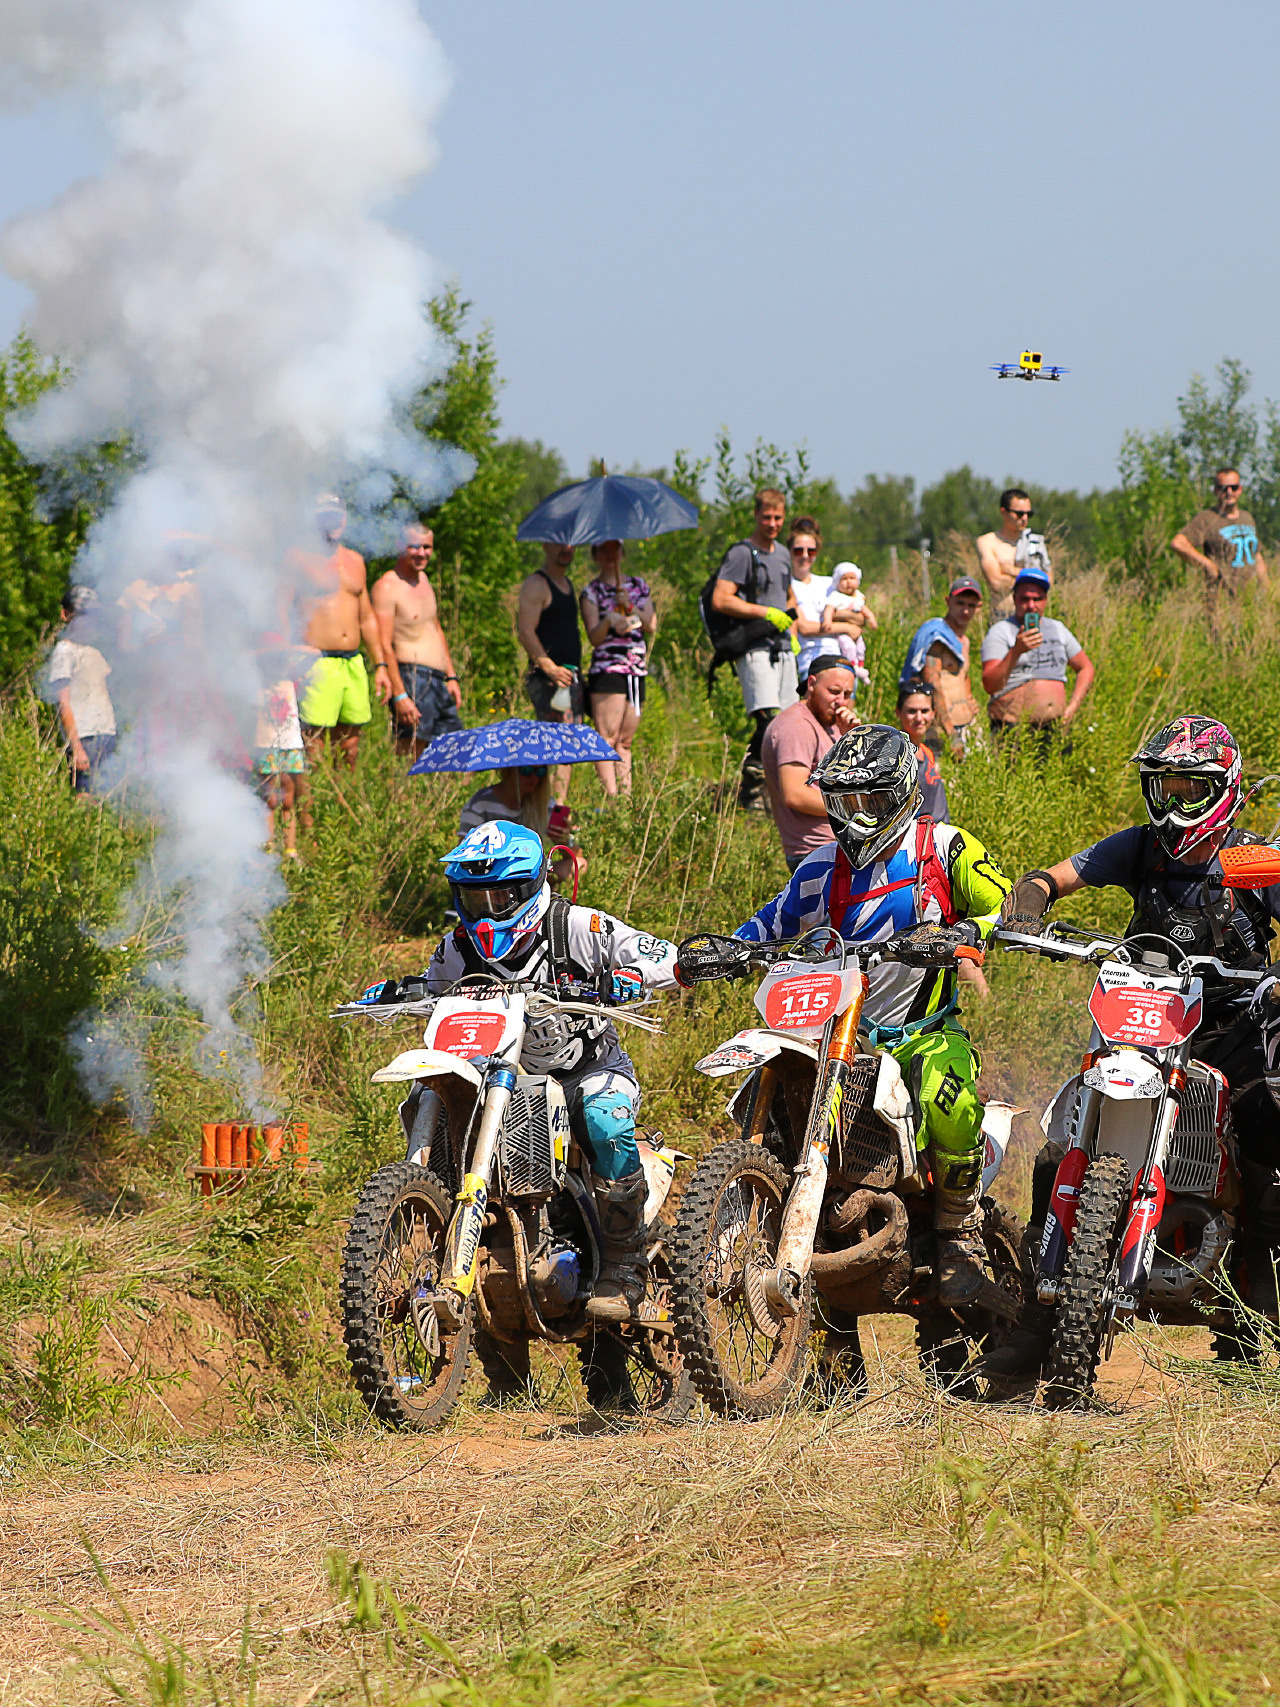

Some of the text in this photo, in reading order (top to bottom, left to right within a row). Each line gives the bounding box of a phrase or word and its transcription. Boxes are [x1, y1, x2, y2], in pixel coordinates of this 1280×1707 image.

[1104, 978, 1128, 986] Maksim
[781, 992, 831, 1012] 115
[1125, 1007, 1162, 1028] 36
[460, 1028, 477, 1044] 3
[934, 1064, 965, 1117] FOX
